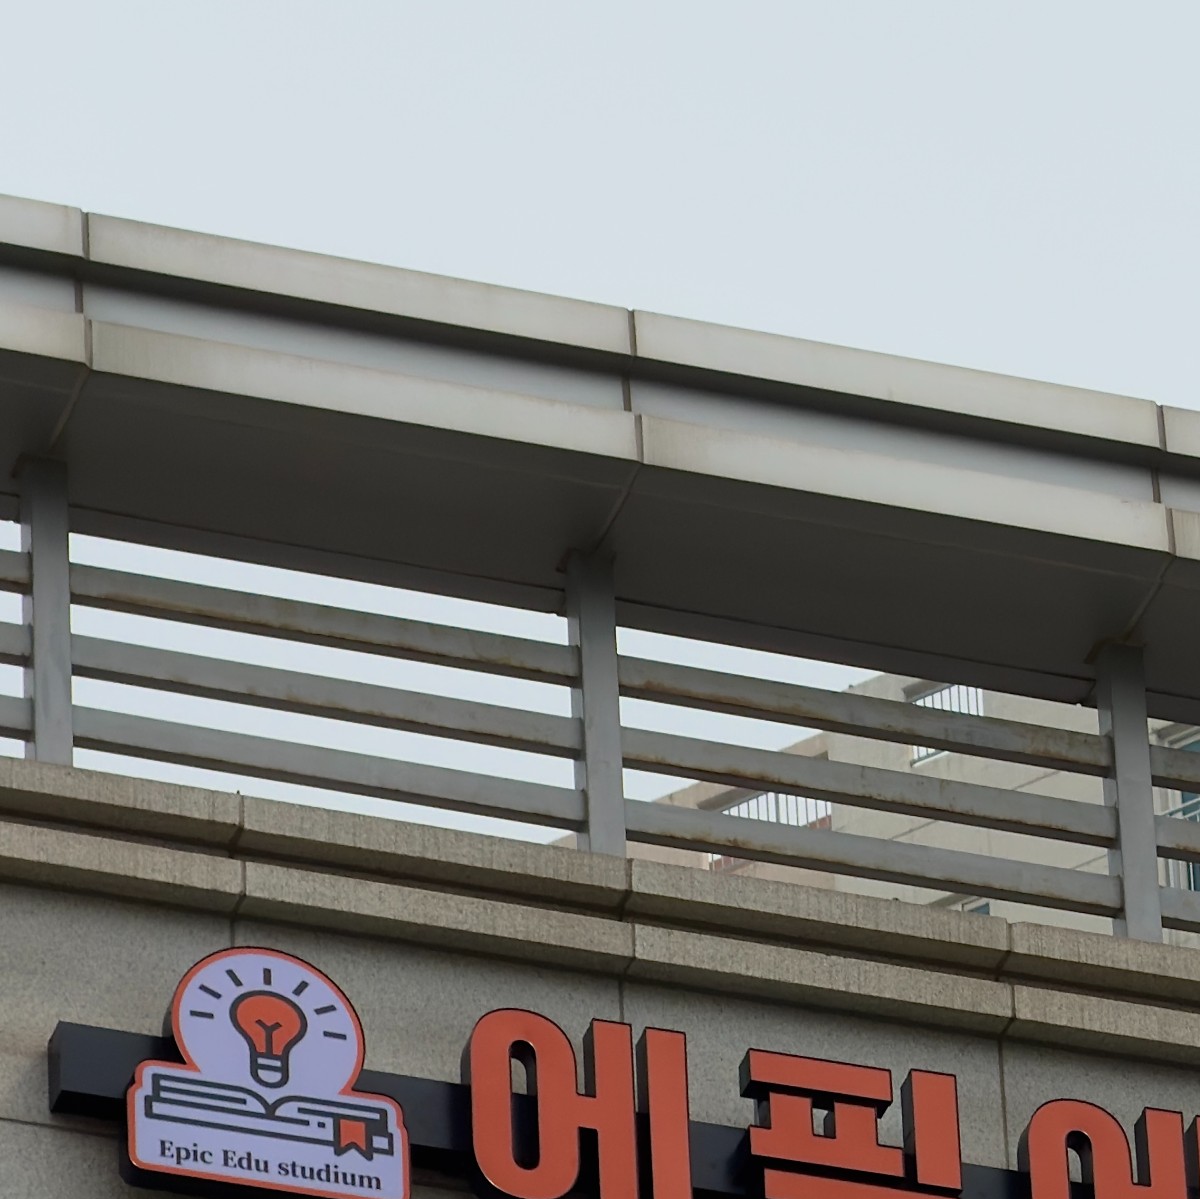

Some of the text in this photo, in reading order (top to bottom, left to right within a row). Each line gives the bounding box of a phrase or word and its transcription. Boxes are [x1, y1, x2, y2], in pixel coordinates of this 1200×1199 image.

[159, 1139, 382, 1190] Epic Edu studium
